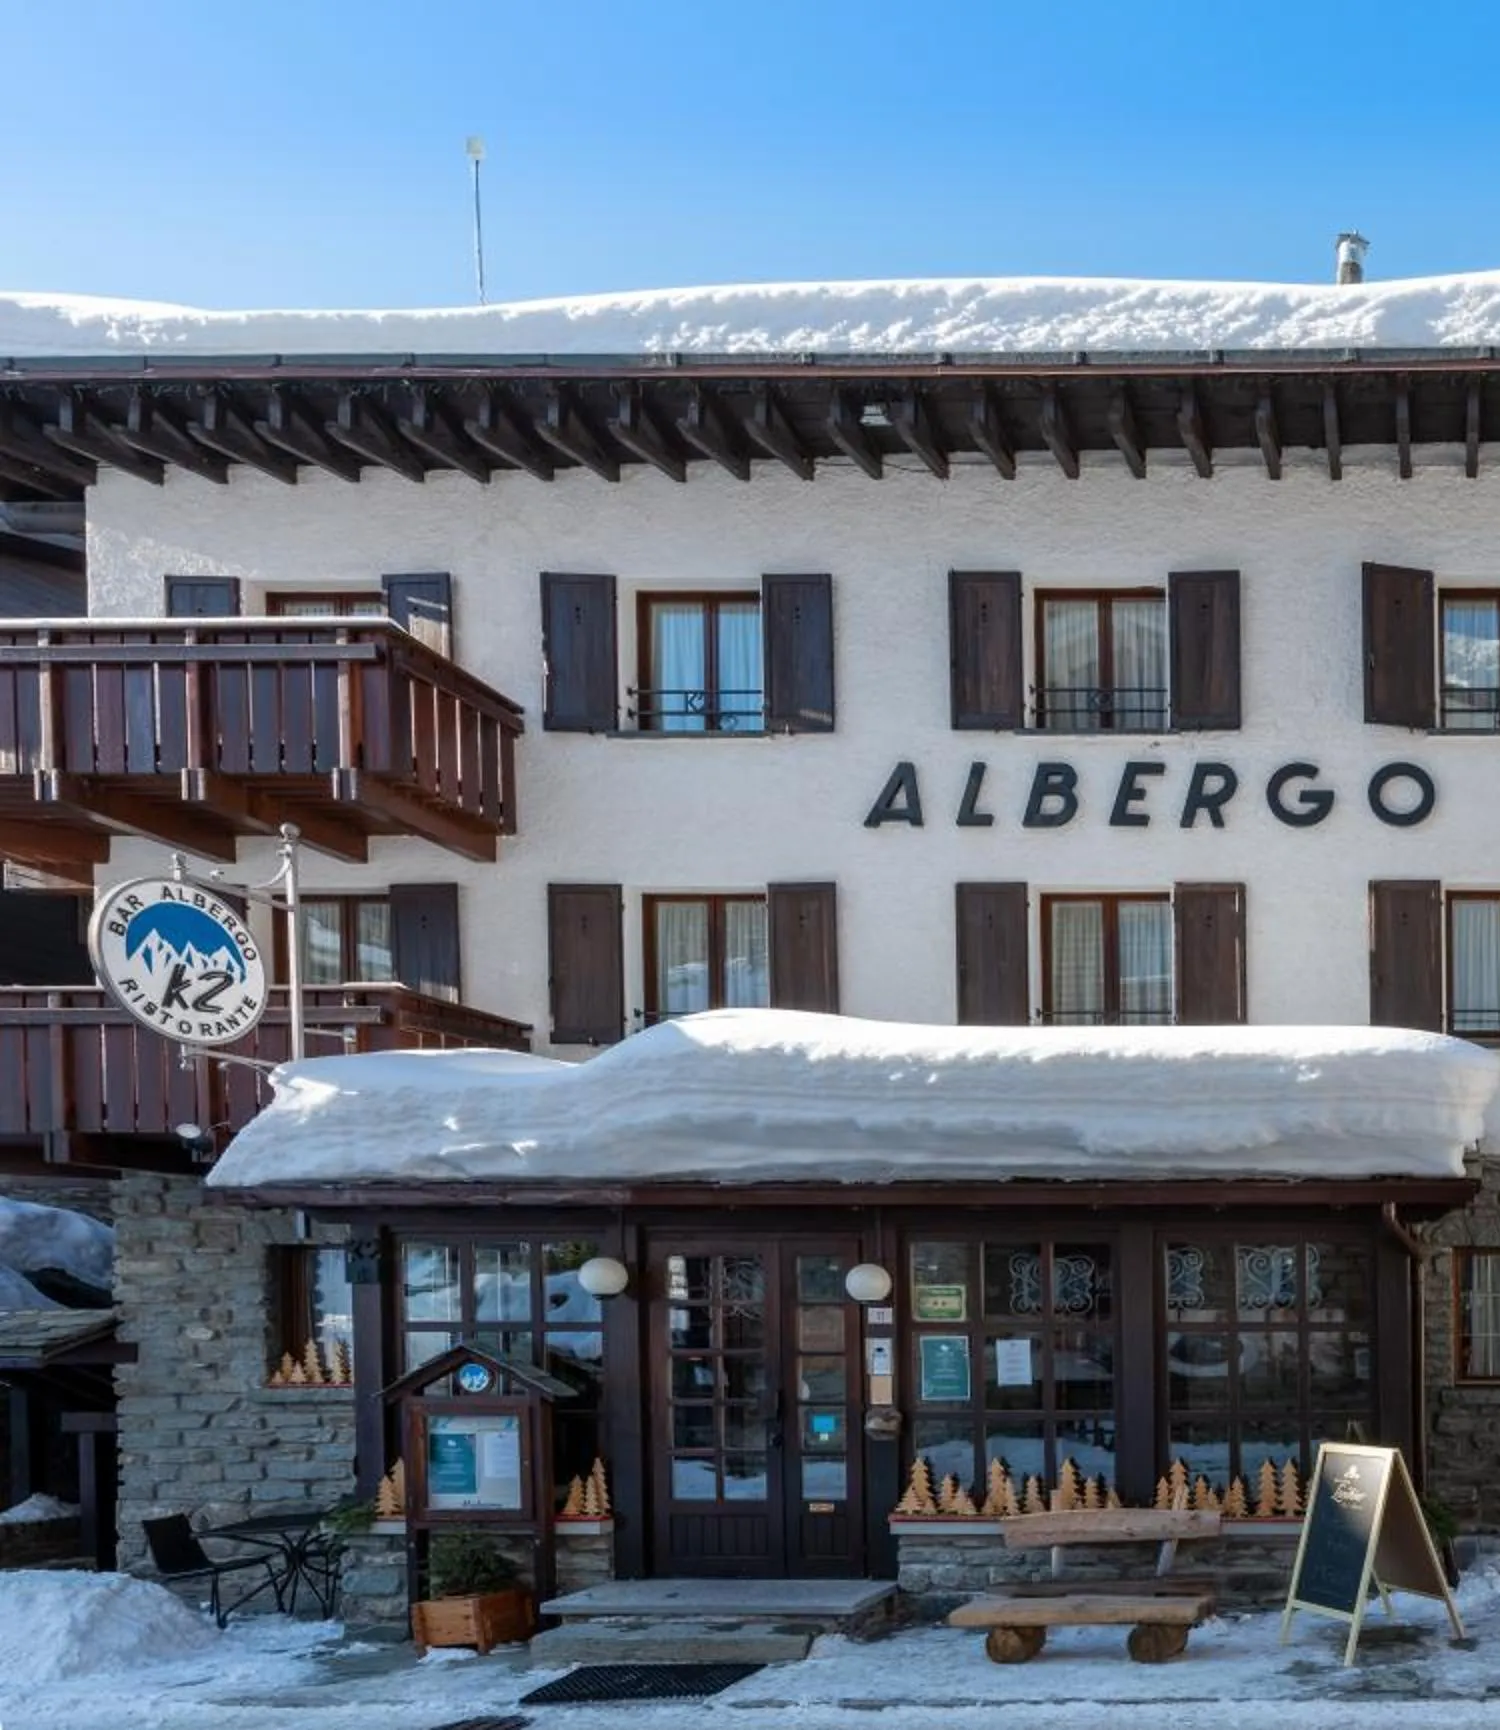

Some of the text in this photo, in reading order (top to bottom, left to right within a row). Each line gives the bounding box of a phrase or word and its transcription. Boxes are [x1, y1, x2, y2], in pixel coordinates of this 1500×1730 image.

[864, 761, 1436, 828] ALBERGO
[107, 885, 257, 961] BAR ALBERGO
[118, 978, 258, 1037] RISTORANTE
